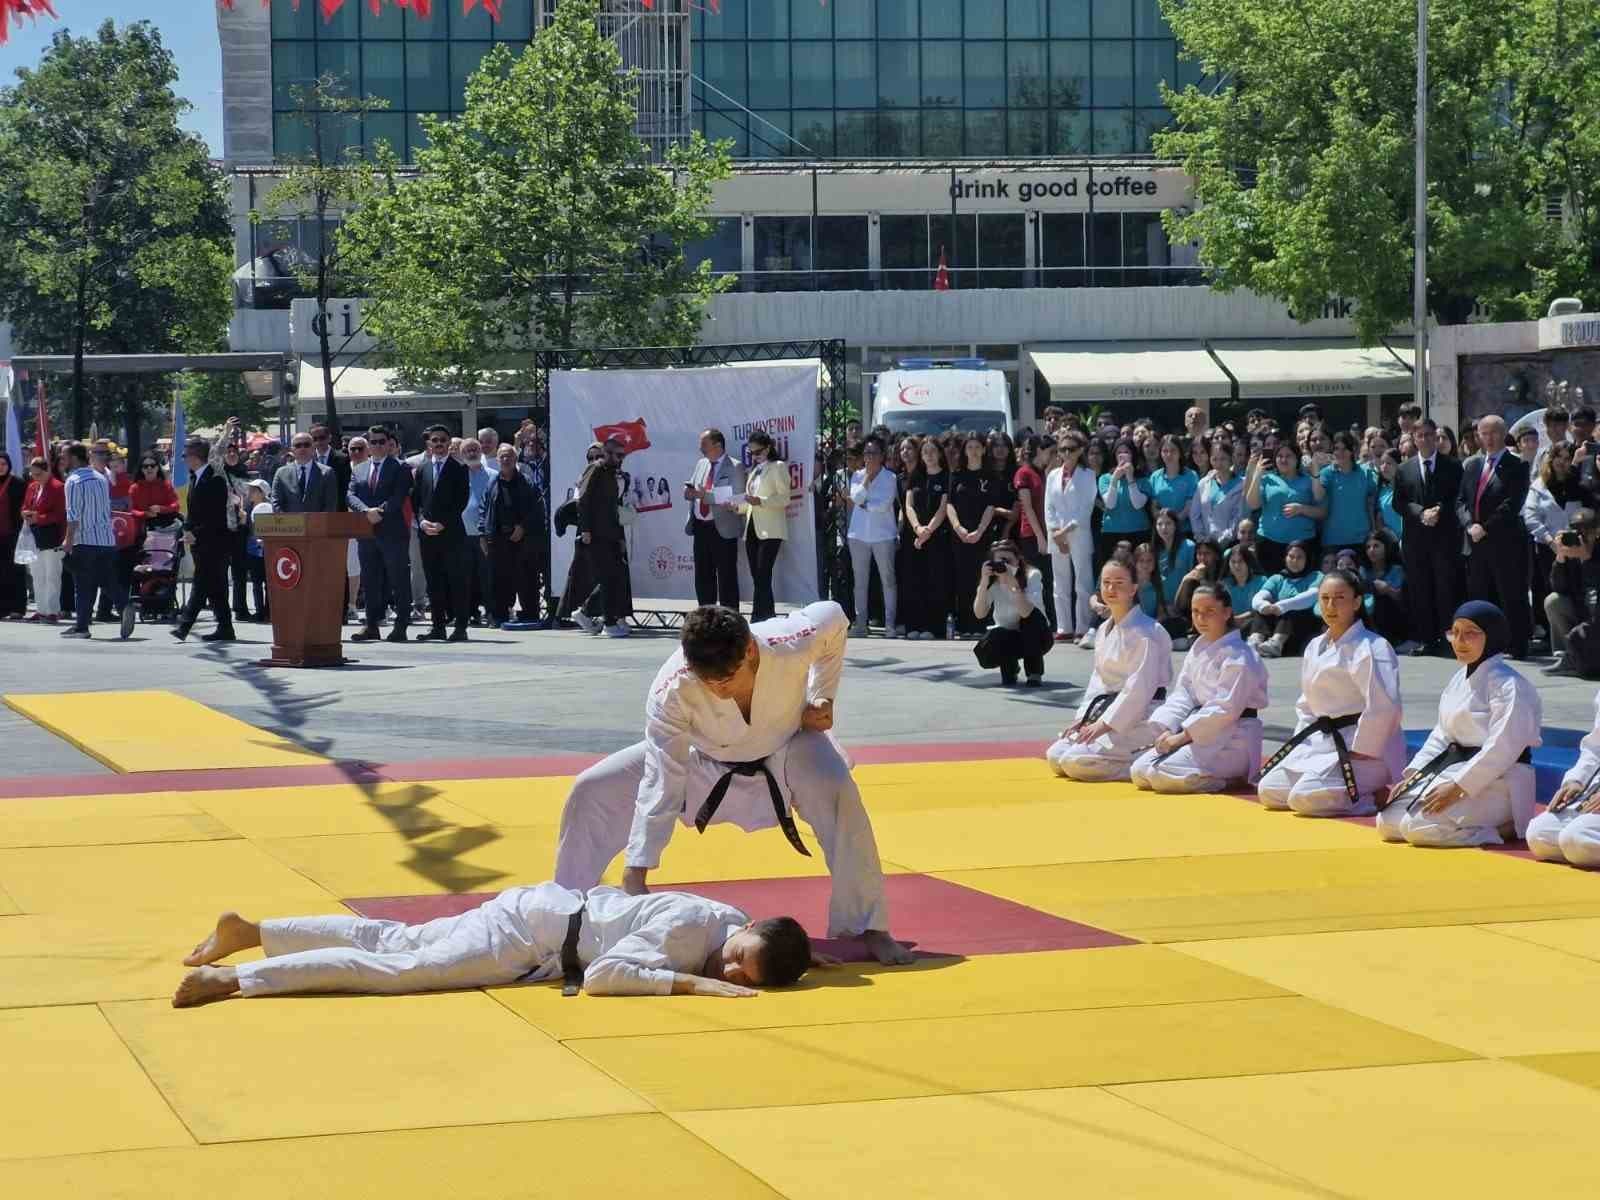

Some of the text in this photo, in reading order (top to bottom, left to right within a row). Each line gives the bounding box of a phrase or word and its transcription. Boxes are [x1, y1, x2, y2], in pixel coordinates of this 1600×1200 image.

[949, 177, 1158, 202] drink good coffee
